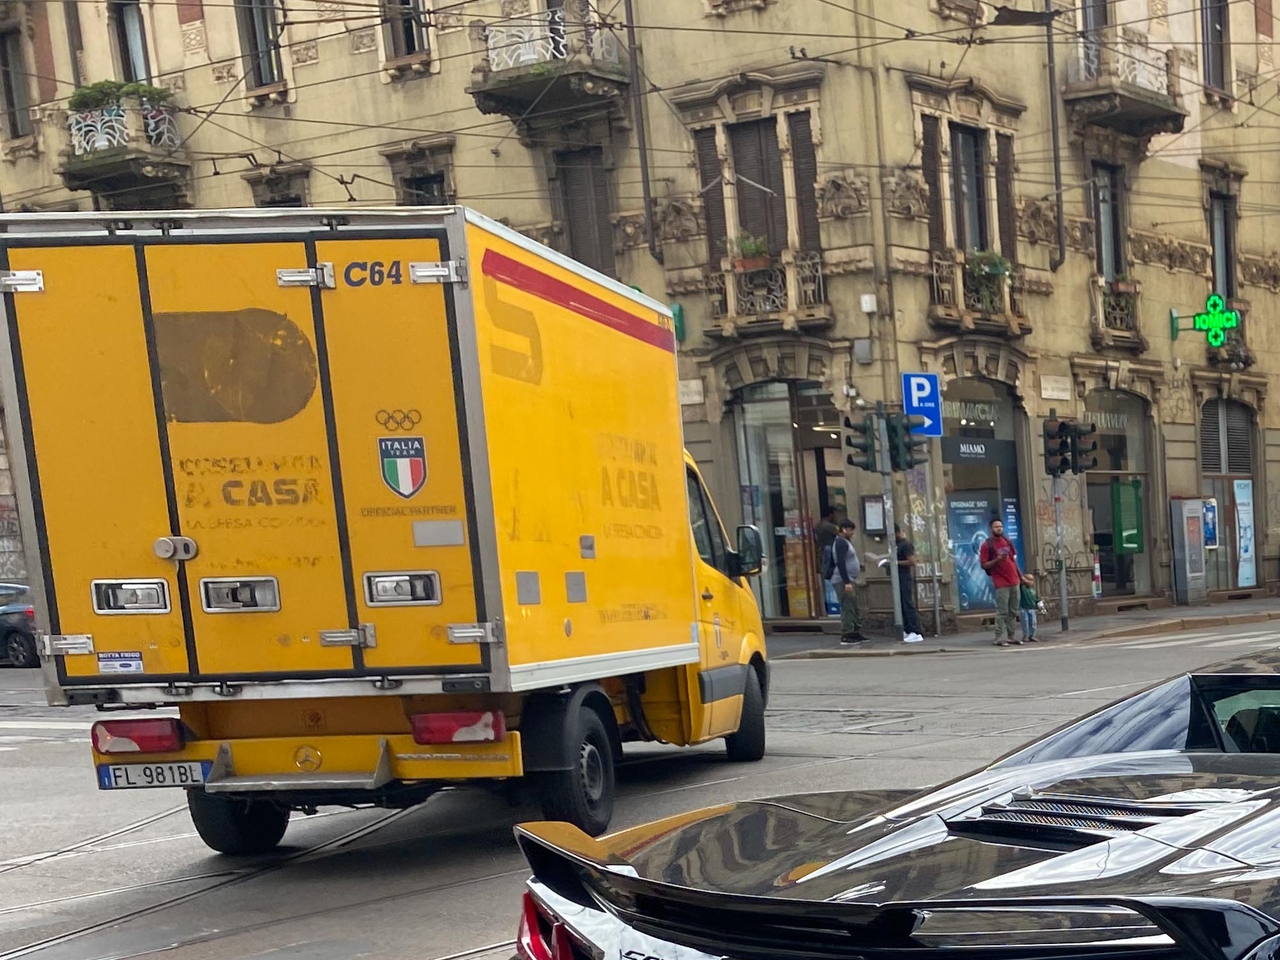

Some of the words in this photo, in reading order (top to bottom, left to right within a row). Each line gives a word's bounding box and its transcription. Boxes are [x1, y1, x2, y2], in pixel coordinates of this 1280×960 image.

[344, 261, 402, 287] C64
[910, 377, 931, 407] P
[381, 441, 420, 449] ITALIA
[960, 444, 985, 453] MIAMO
[221, 479, 321, 507] CASA
[112, 767, 137, 787] FL
[144, 764, 201, 785] 981BL
